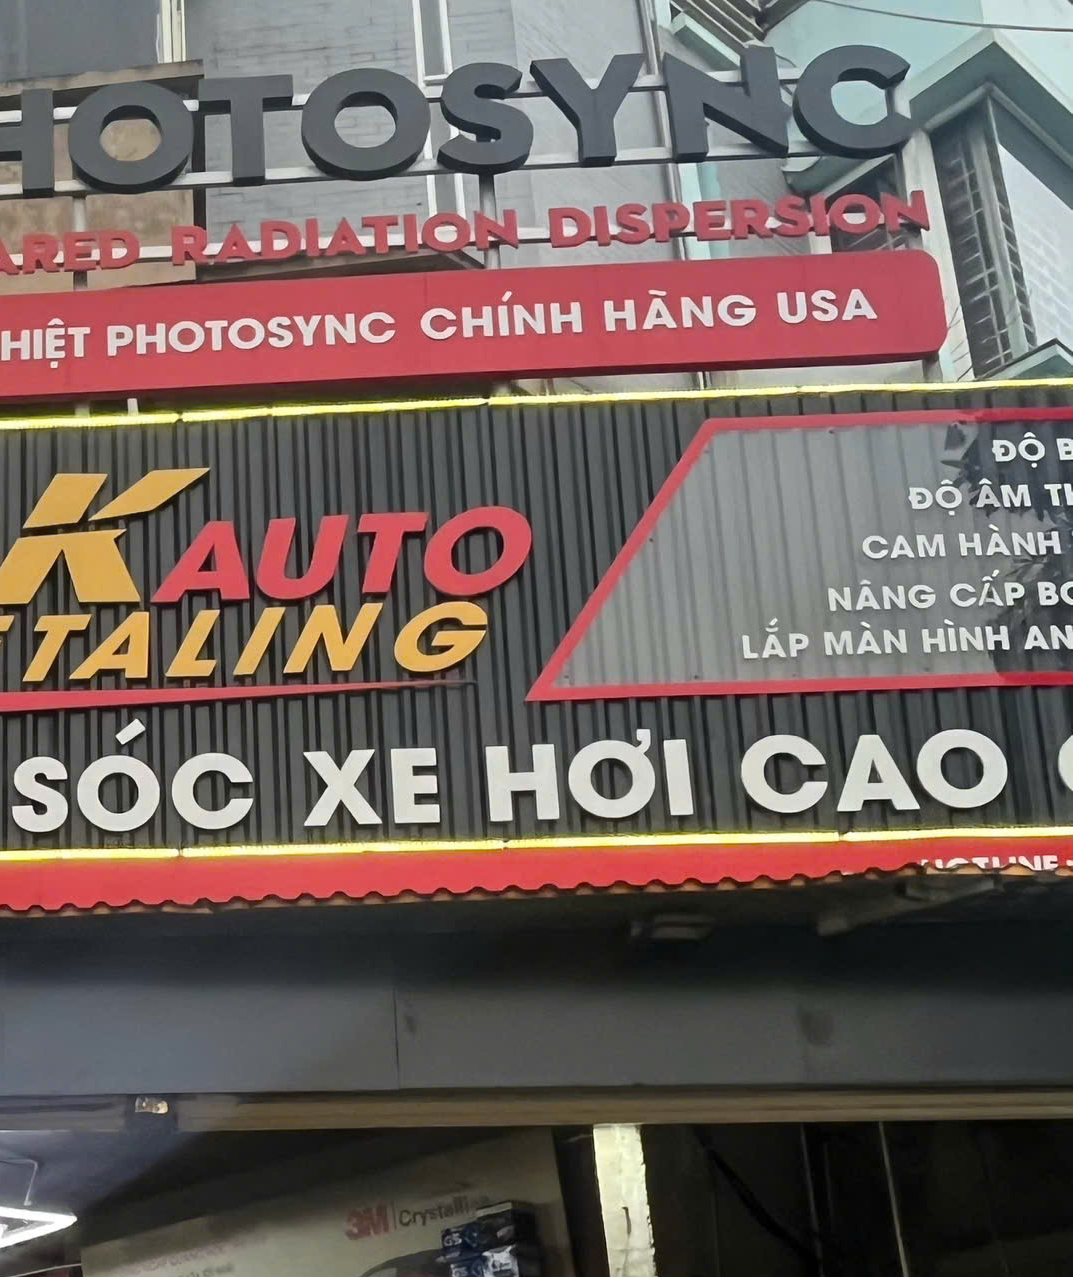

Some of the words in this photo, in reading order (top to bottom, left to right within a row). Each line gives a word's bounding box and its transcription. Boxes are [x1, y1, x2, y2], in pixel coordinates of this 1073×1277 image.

[172, 209, 520, 266] RADIATION
[549, 190, 931, 249] DISPERSION
[107, 313, 397, 358] PHOTOSYNC
[420, 292, 583, 342] CHÍNH
[604, 288, 757, 333] HÀNG
[777, 288, 879, 324] USA
[992, 431, 1046, 468] ĐỘ
[908, 479, 963, 516] ĐỘ
[975, 477, 1032, 508] ÂM
[151, 506, 533, 603] AUTO
[862, 533, 946, 560] CAM
[959, 523, 1063, 556] HÀNH
[827, 579, 937, 612] NÂNG
[949, 569, 1026, 608] CẤP
[742, 618, 810, 660] LẮP
[823, 621, 908, 656] MÀN
[921, 619, 1011, 654] HÌNH
[11, 719, 255, 834] SÓC
[303, 746, 442, 829] XE
[485, 728, 695, 823] HƠI
[740, 729, 1009, 815] CAO
